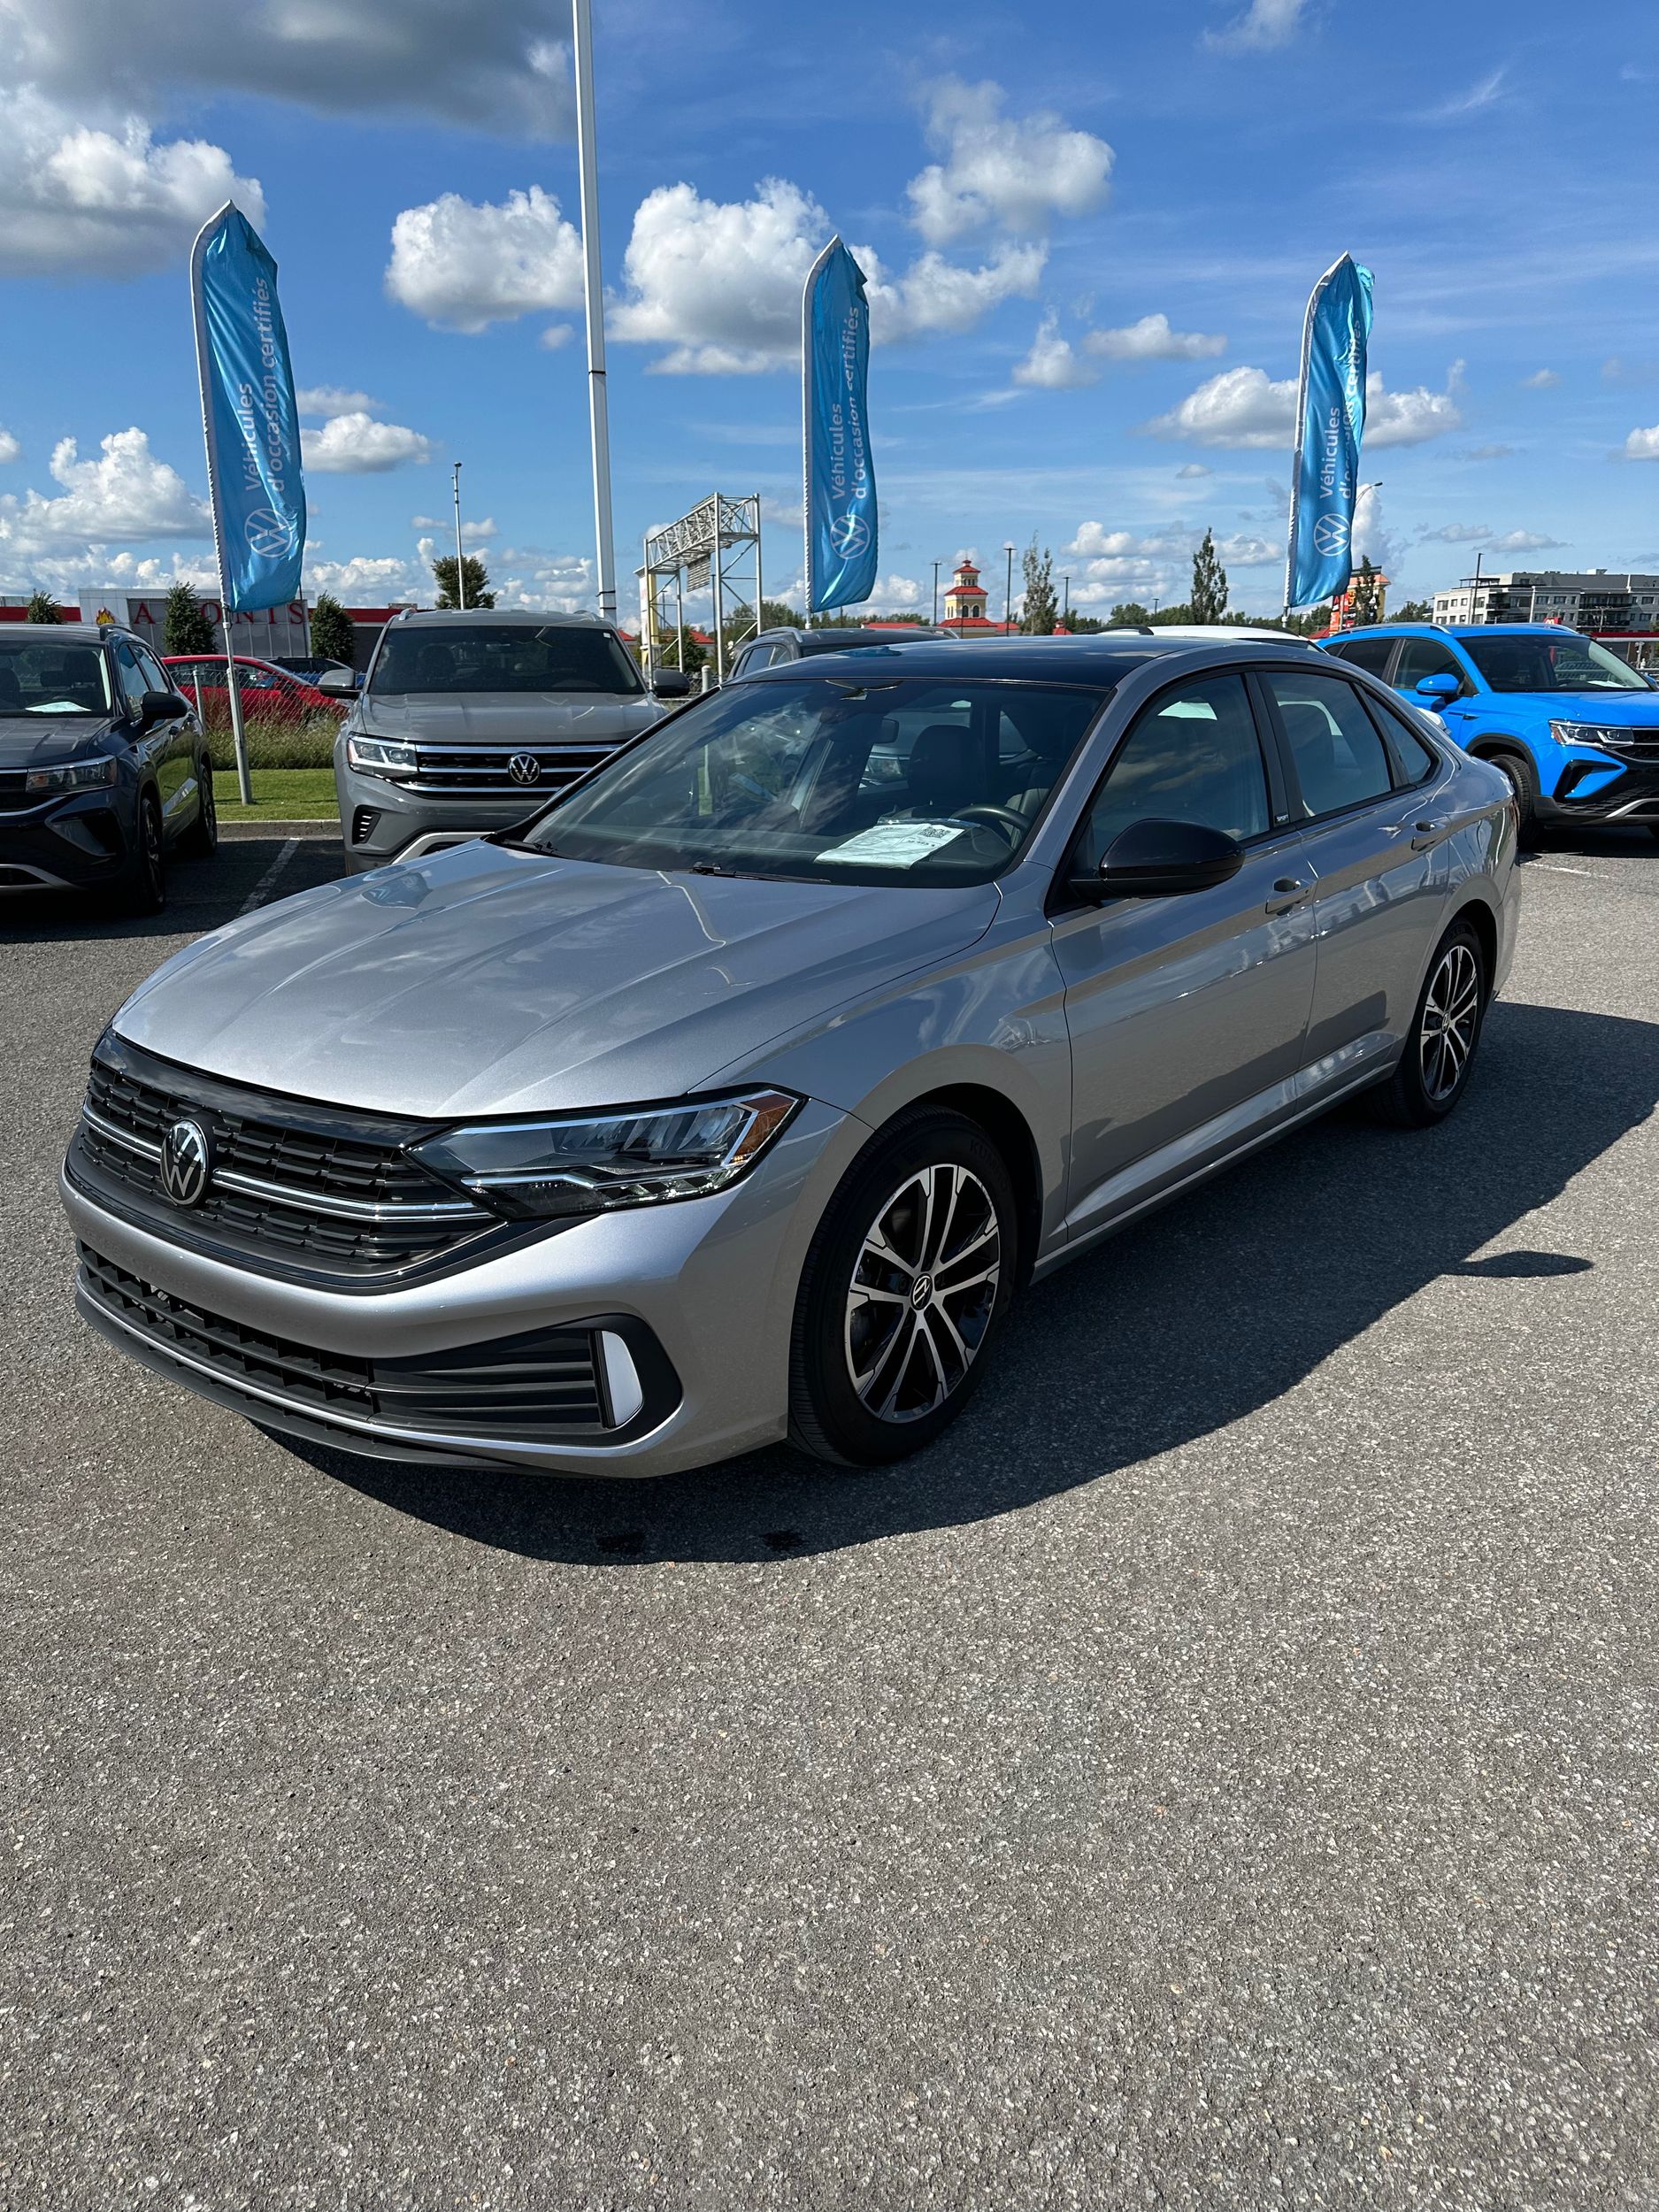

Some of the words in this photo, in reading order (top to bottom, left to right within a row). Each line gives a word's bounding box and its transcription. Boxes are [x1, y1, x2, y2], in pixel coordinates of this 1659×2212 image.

[251, 277, 275, 369] certifiés
[239, 383, 262, 492] Véhicules
[262, 376, 284, 493] d'occasion
[828, 403, 846, 500] Véhicules
[846, 398, 866, 500] d'occasion
[1319, 407, 1340, 499] Véhicules
[134, 603, 305, 625] AONIS
